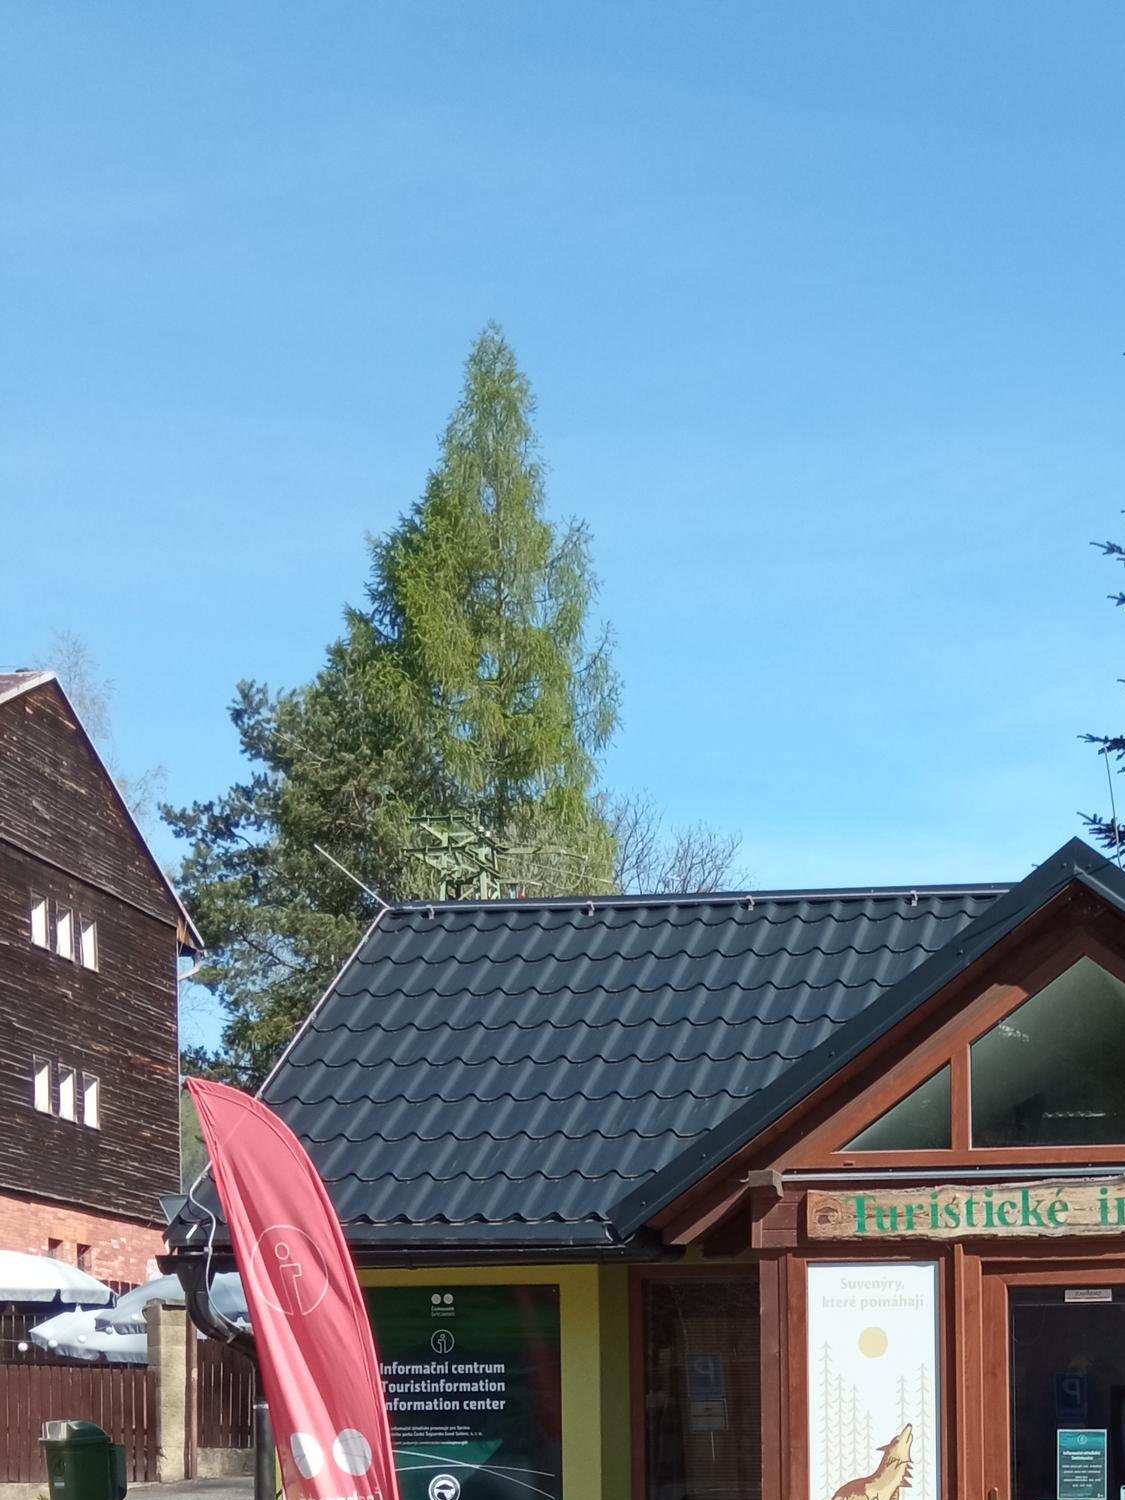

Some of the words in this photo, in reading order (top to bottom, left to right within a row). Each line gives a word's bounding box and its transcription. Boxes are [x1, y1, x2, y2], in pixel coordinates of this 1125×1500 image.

[844, 1187, 1069, 1233] Turistické
[380, 1361, 449, 1375] Informační
[451, 1362, 505, 1374] centrum
[381, 1379, 505, 1393] Touristinformation
[385, 1398, 460, 1411] nformation
[463, 1398, 506, 1410] center
